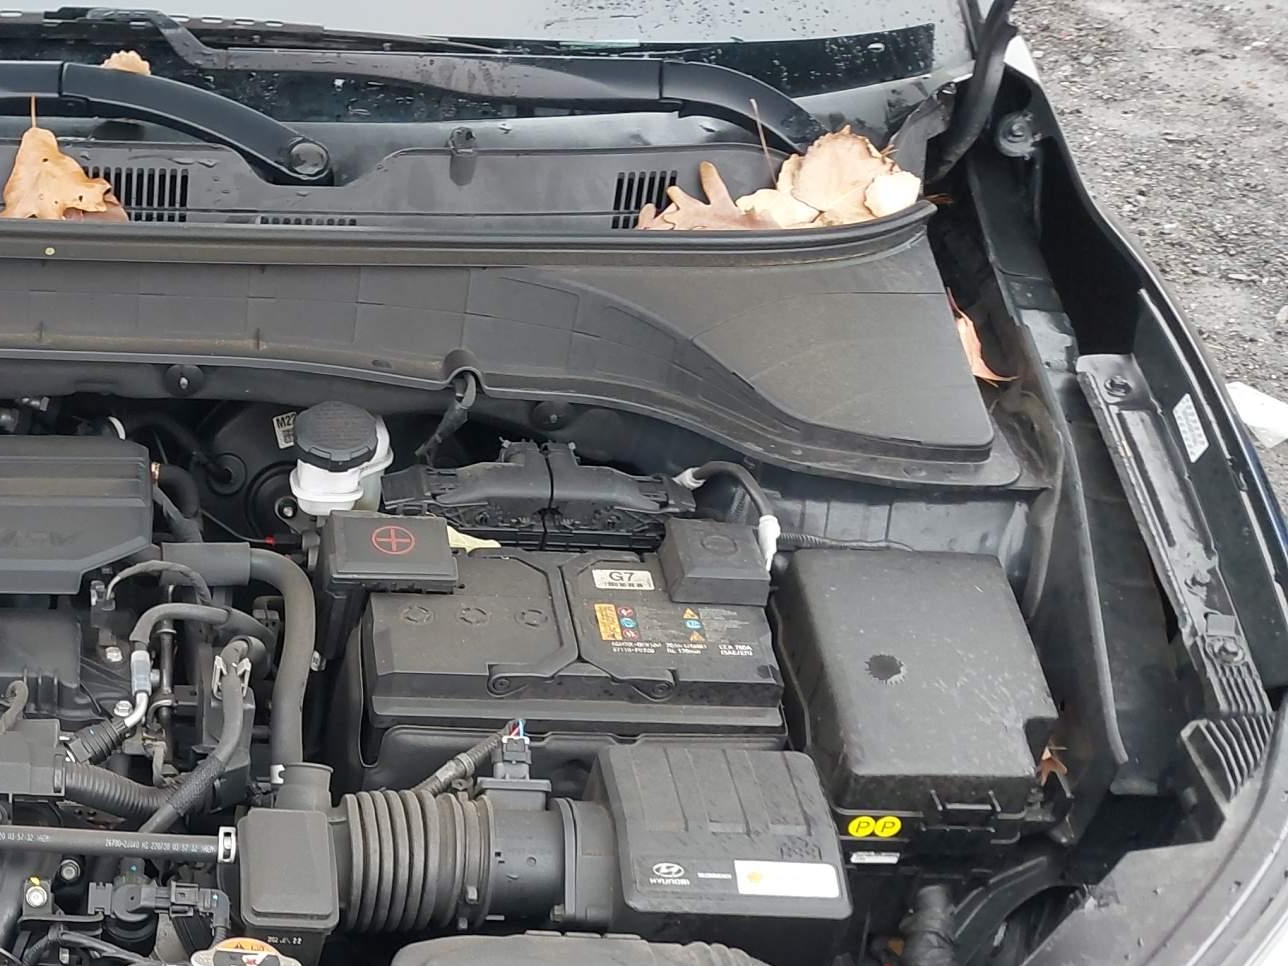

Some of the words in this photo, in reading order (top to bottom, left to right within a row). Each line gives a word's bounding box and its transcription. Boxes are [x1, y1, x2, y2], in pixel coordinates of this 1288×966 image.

[608, 571, 634, 582] G7
[855, 820, 871, 833] P
[880, 820, 896, 833] P
[649, 877, 691, 886] HYUNDAI
